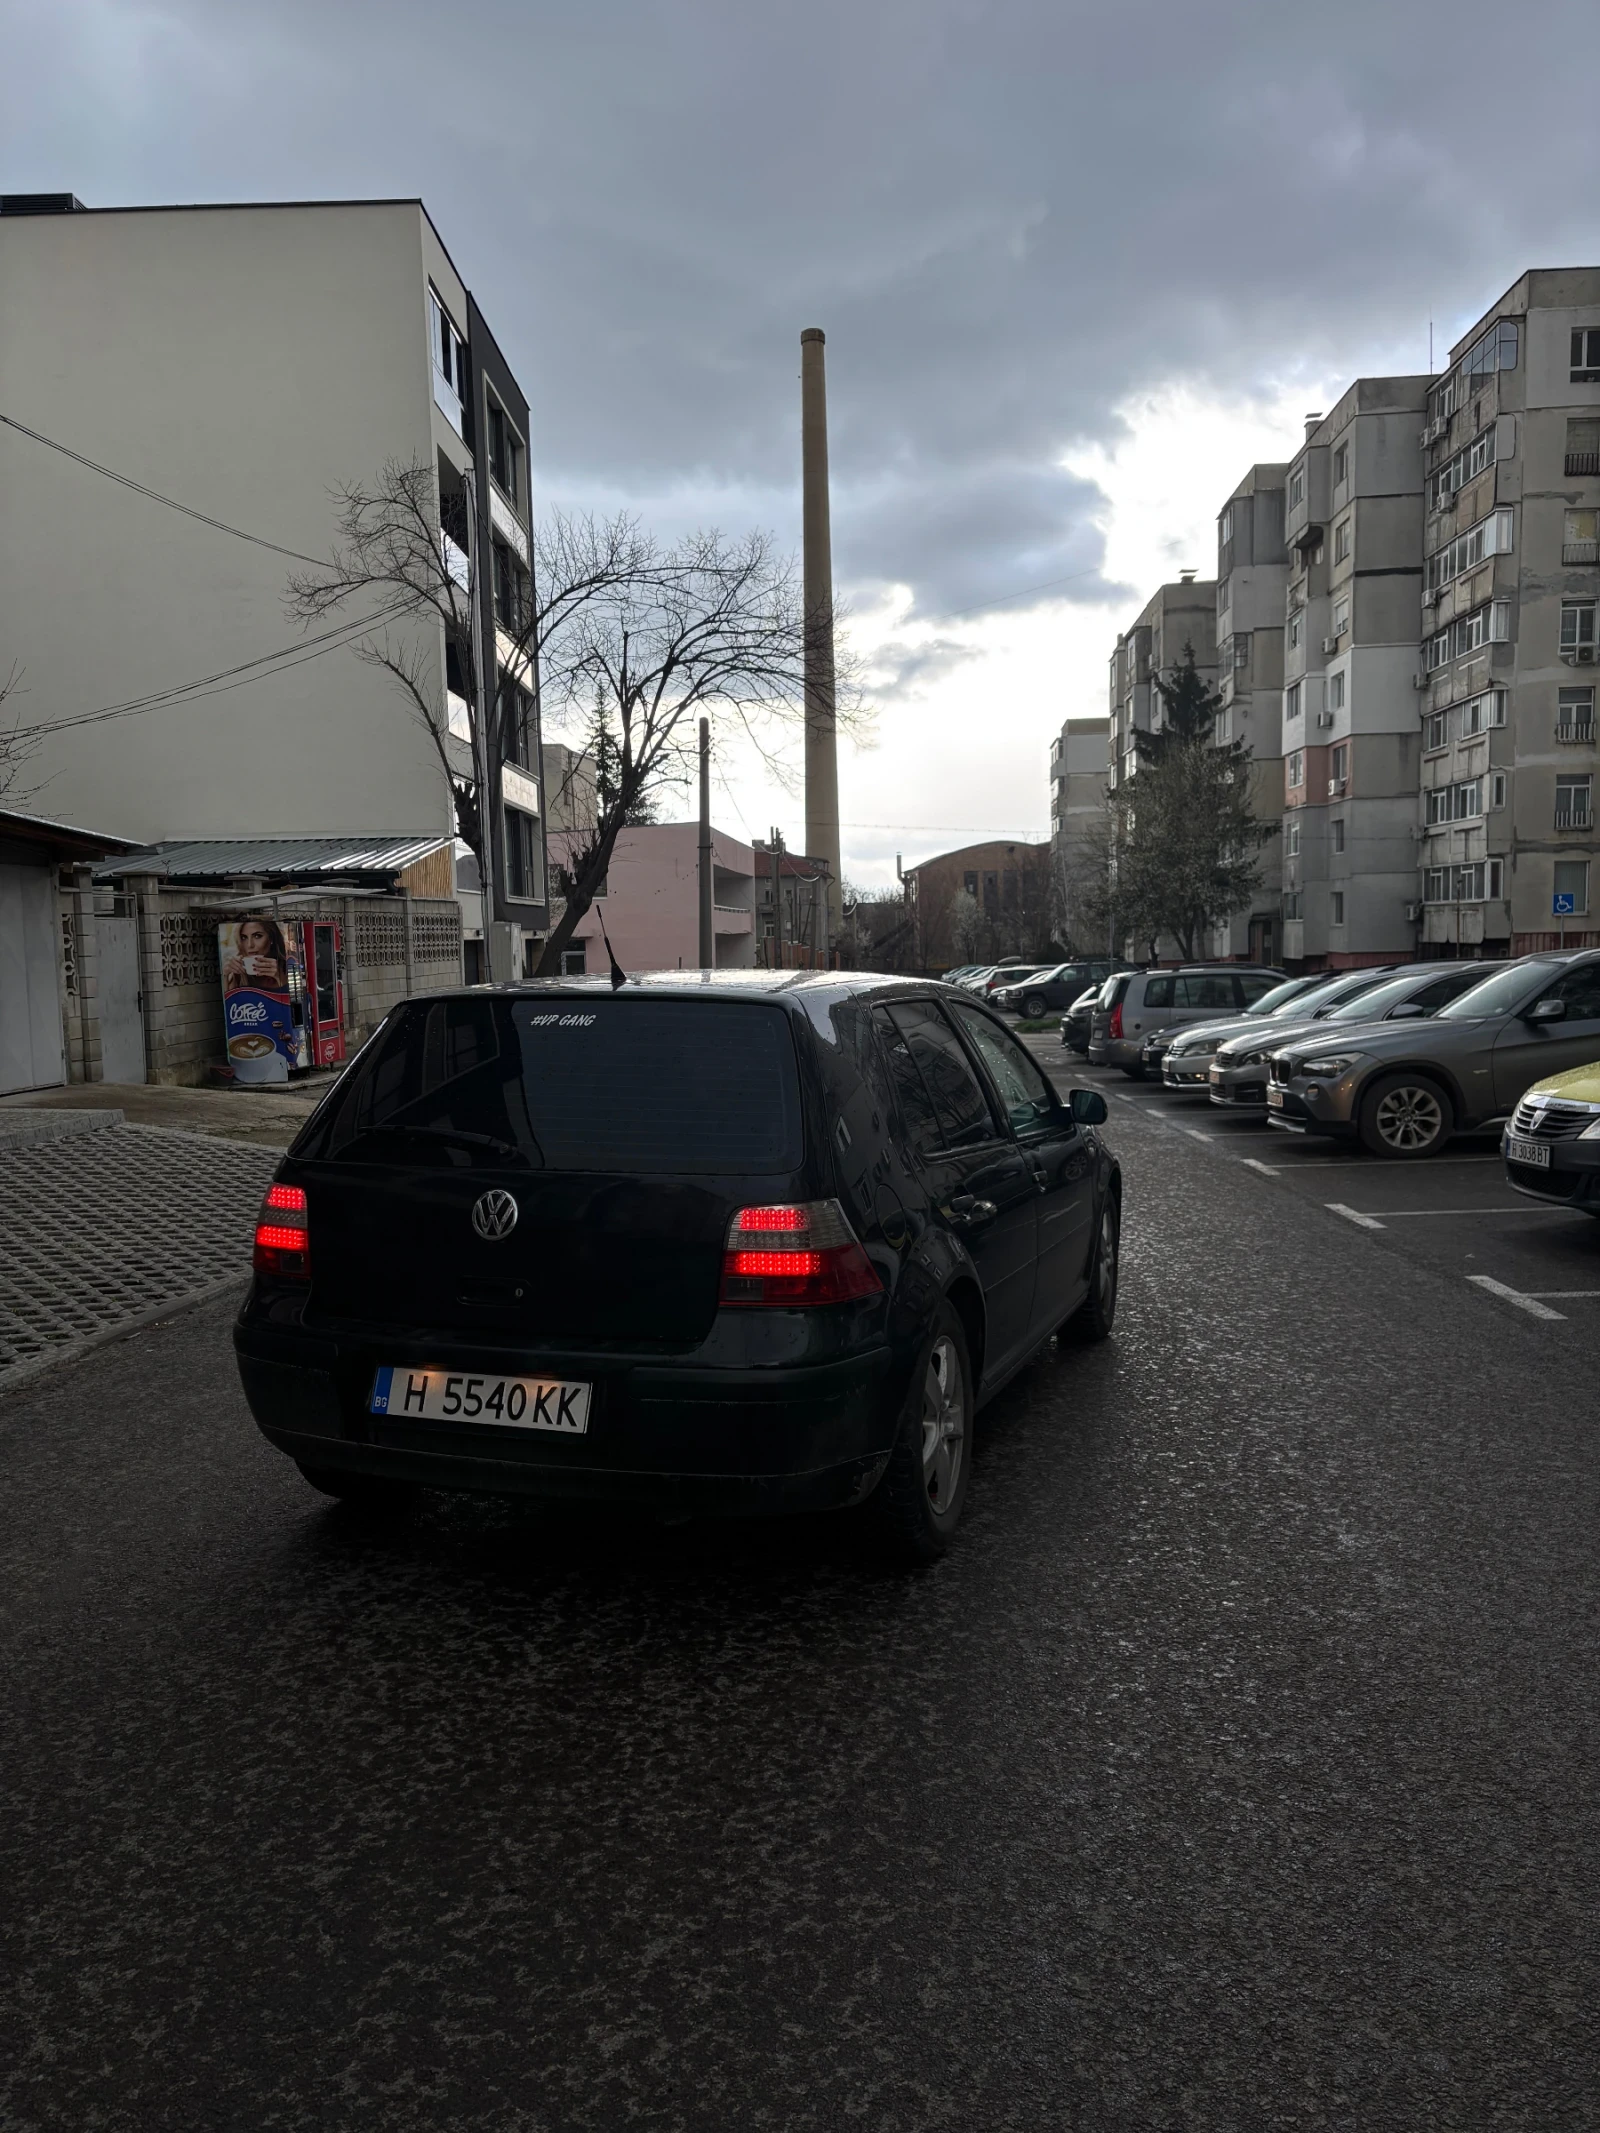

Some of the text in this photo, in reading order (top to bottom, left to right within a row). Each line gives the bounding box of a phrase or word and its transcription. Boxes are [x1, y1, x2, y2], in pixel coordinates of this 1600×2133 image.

[530, 1015, 596, 1026] #VP GANG
[1512, 1144, 1517, 1157] H
[1537, 1147, 1549, 1164] BT
[374, 1395, 388, 1408] BG
[403, 1374, 581, 1427] H 5540 KK
